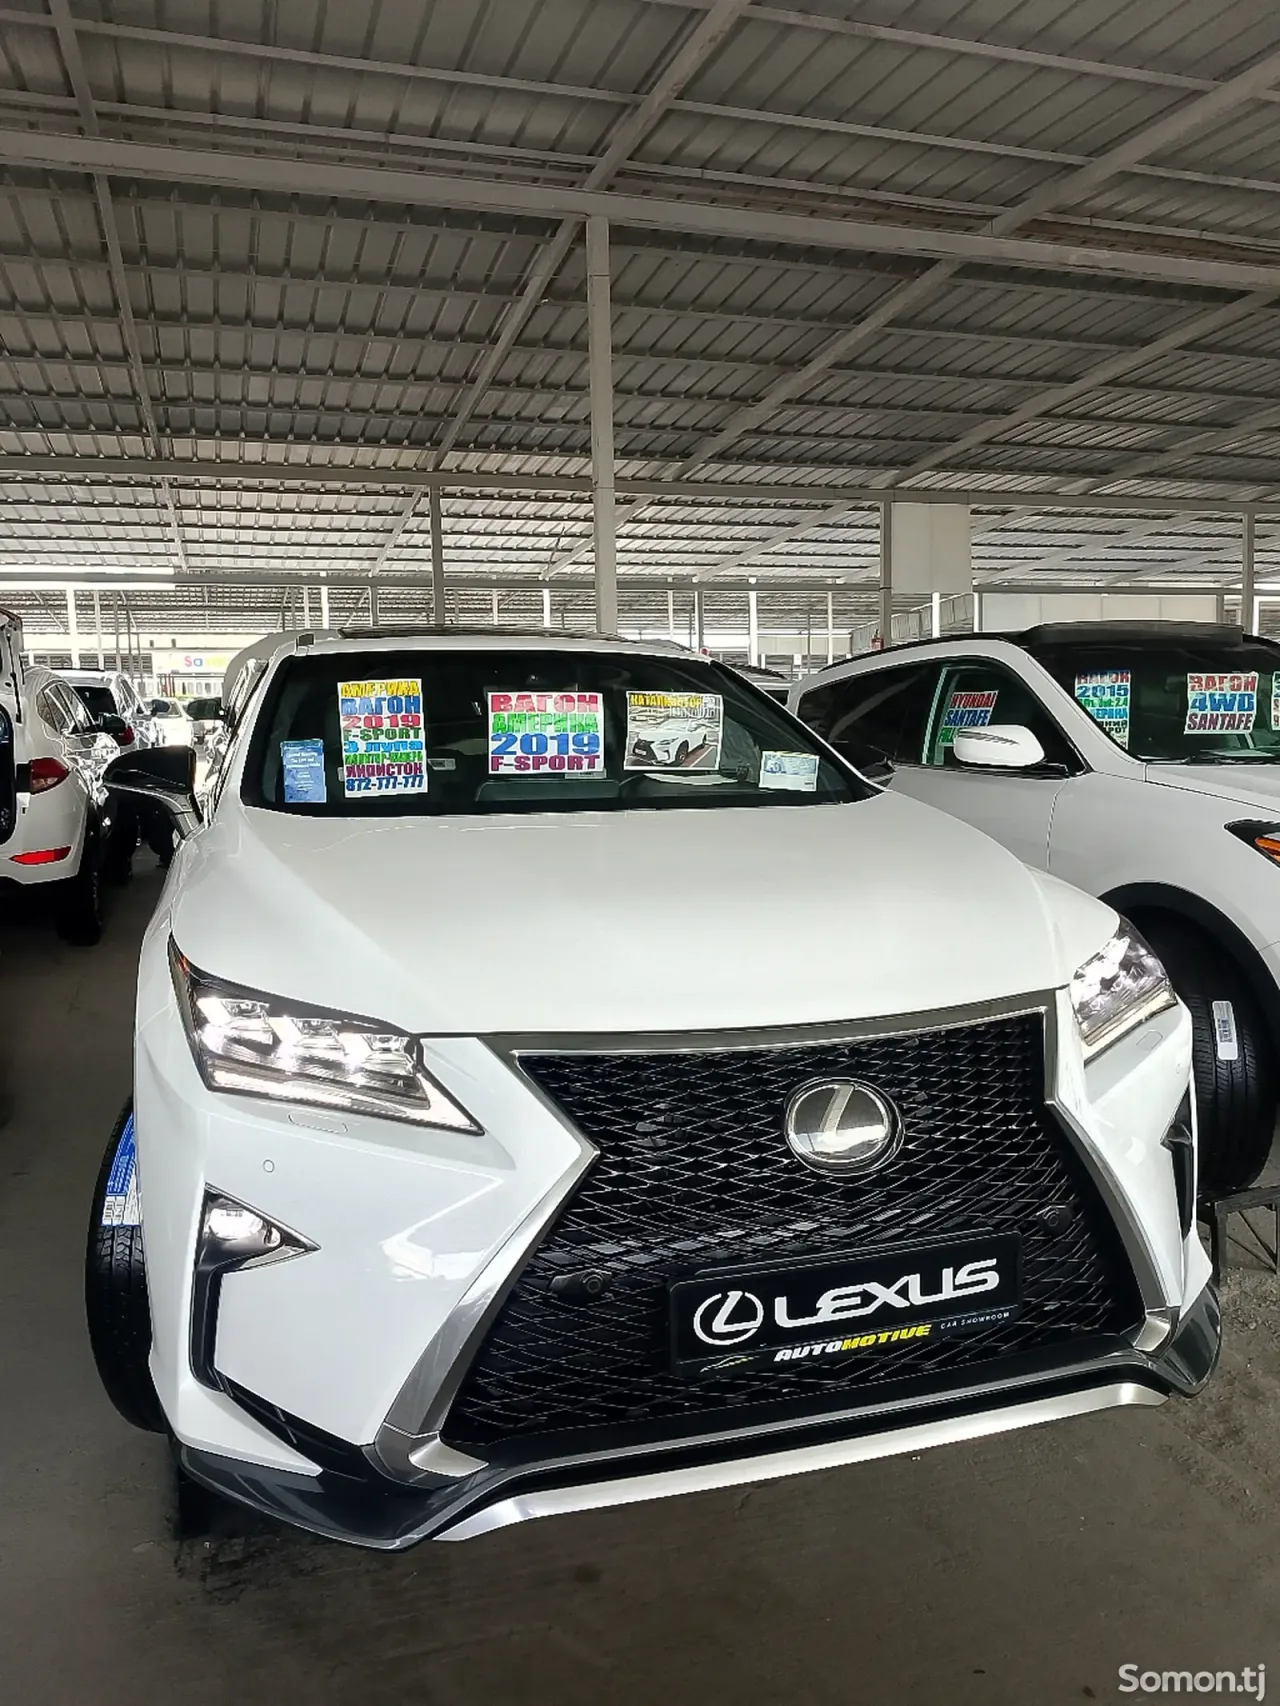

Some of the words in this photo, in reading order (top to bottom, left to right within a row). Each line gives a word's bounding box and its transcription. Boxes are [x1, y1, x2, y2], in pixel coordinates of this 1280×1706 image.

[1077, 684, 1129, 698] 2015
[1189, 675, 1257, 692] ВАГОН
[341, 696, 421, 716] ВАГОН
[491, 694, 599, 713] ВАГОН
[1190, 692, 1255, 712] 4WD
[342, 715, 421, 729] 2019
[492, 713, 599, 733] АМЕРИКА
[1091, 708, 1128, 719] ЕРИКА
[342, 727, 421, 741] F-SPORT
[491, 733, 600, 756] 2019
[491, 755, 600, 771] F-SPORT
[774, 1258, 1000, 1328] LEXUS
[773, 1324, 932, 1362] AUTOMOTIVE
[940, 1320, 957, 1330] CAR
[960, 1311, 1010, 1326] SHOWROOM
